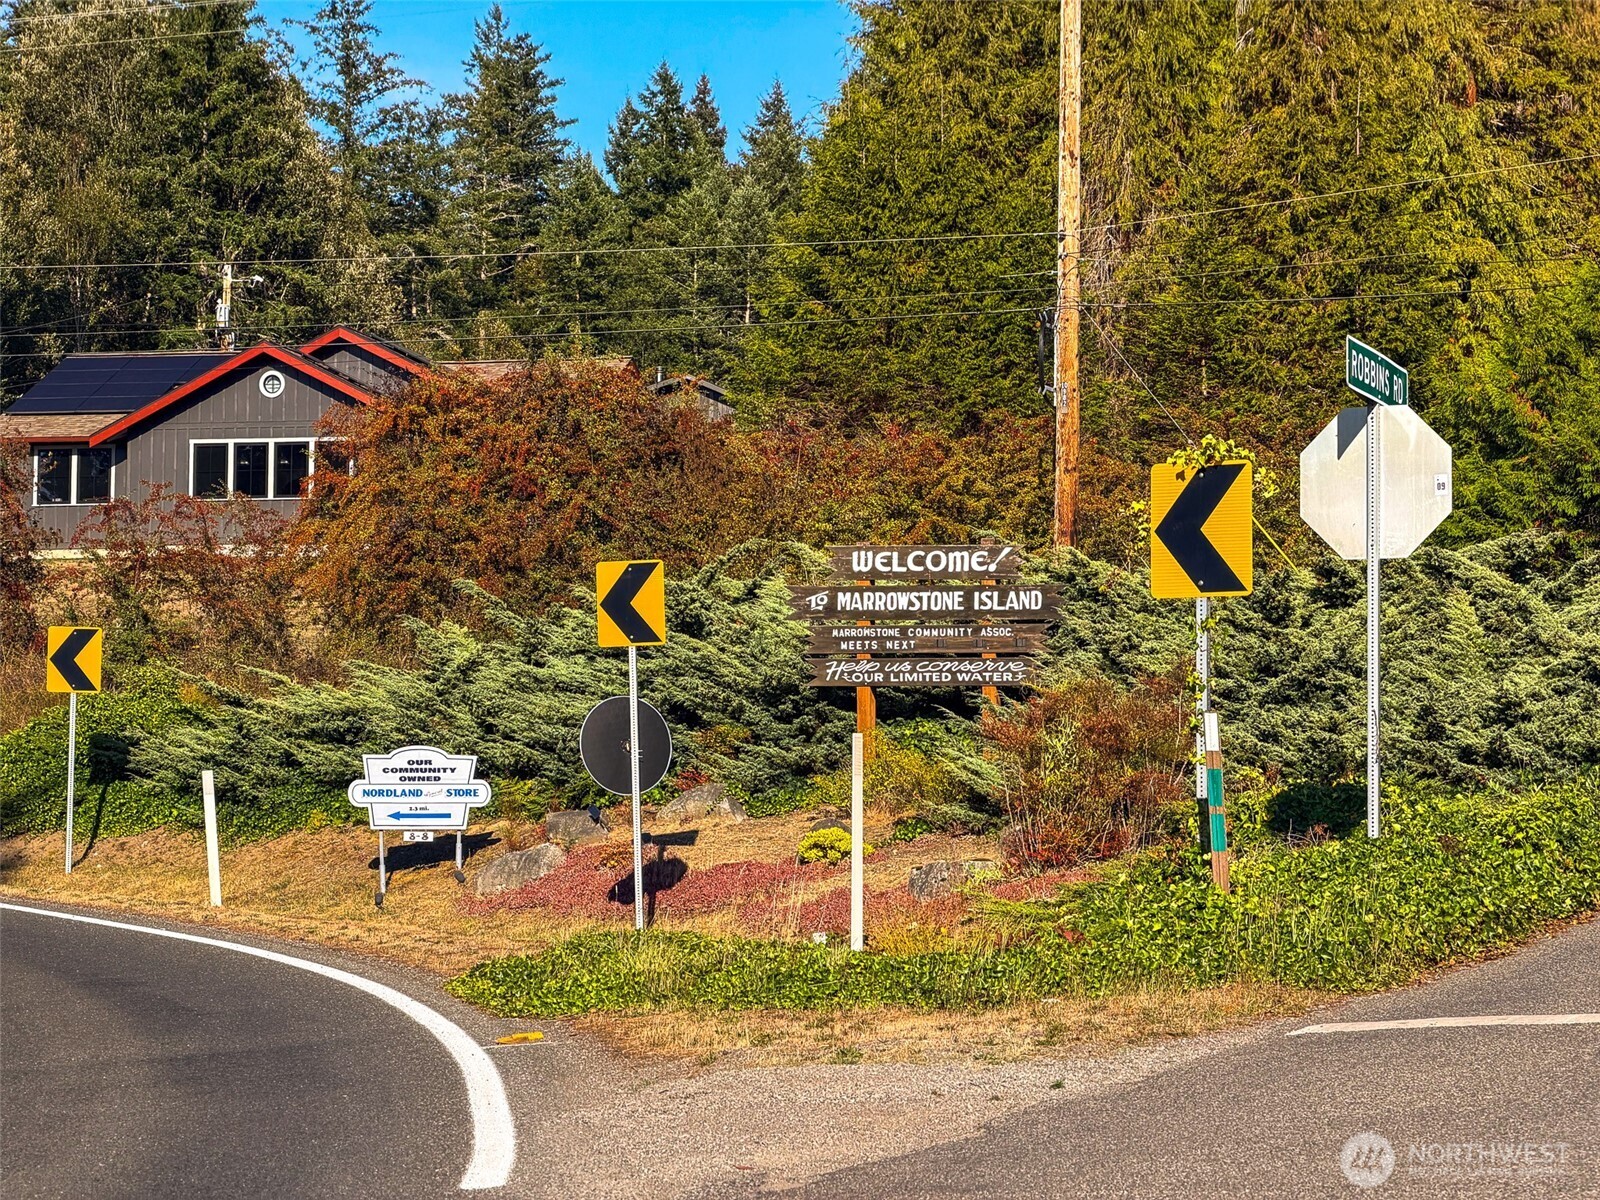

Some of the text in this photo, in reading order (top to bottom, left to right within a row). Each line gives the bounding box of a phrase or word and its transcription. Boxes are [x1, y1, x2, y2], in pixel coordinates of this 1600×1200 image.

[1351, 350, 1404, 404] ROBBINS RD
[851, 546, 1013, 573] WELCOME!
[837, 591, 964, 611] MARROWSTONE
[974, 590, 1043, 610] ISLAND
[832, 626, 1014, 638] MARROWSTONE COMMUNITY ASSOC.
[840, 640, 916, 650] MEETS NEXT
[825, 659, 1027, 681] Help us conserve
[850, 672, 1013, 682] OUR LIMITED WATER
[362, 788, 423, 798] NORDLAND
[446, 788, 480, 798] STORE
